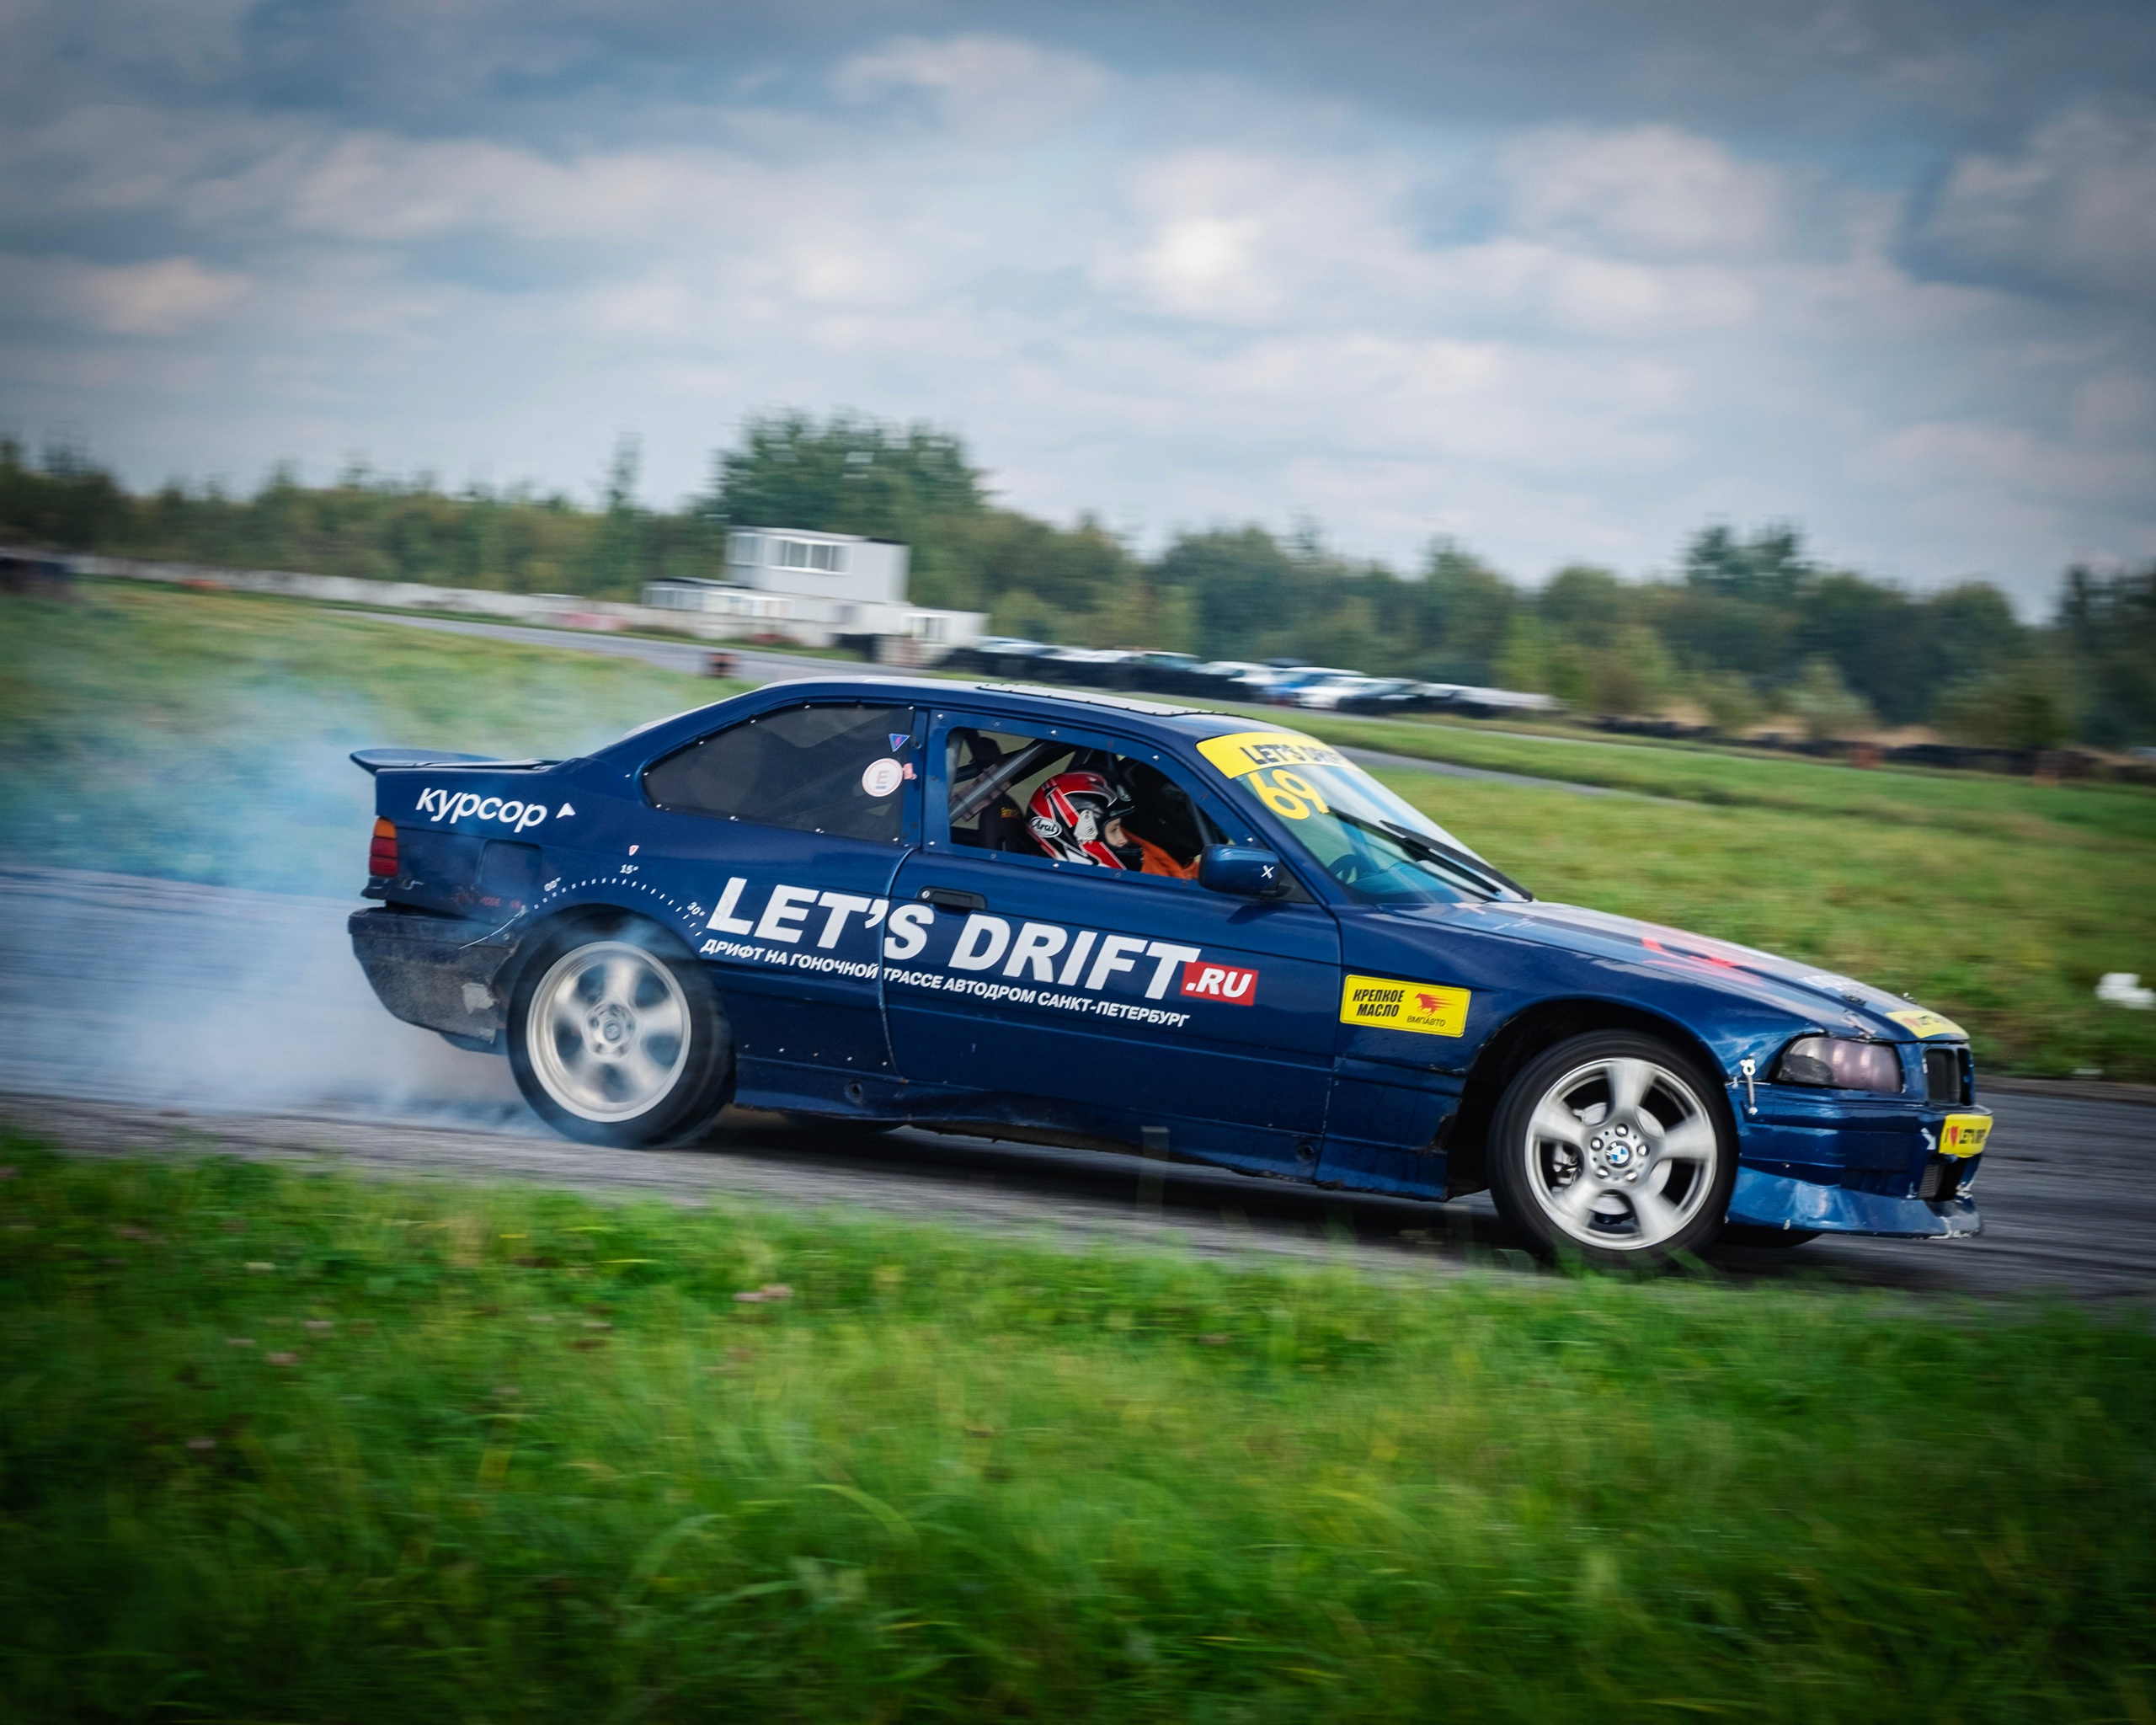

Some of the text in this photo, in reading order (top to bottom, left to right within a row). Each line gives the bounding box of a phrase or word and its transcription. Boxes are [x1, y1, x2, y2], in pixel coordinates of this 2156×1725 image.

[1247, 769, 1330, 820] 69
[706, 877, 934, 960] LET'S
[947, 914, 1202, 1000] DRIFT
[700, 938, 1191, 1028] ДРИФТ НА ГОНОЧНОЙ ТРАССЕ АВТОДРОМ САНКТ-ПЕТЕРБУРГ
[1352, 989, 1405, 1003] КРЕПКОЕ
[1356, 1003, 1400, 1017] МАСЛО
